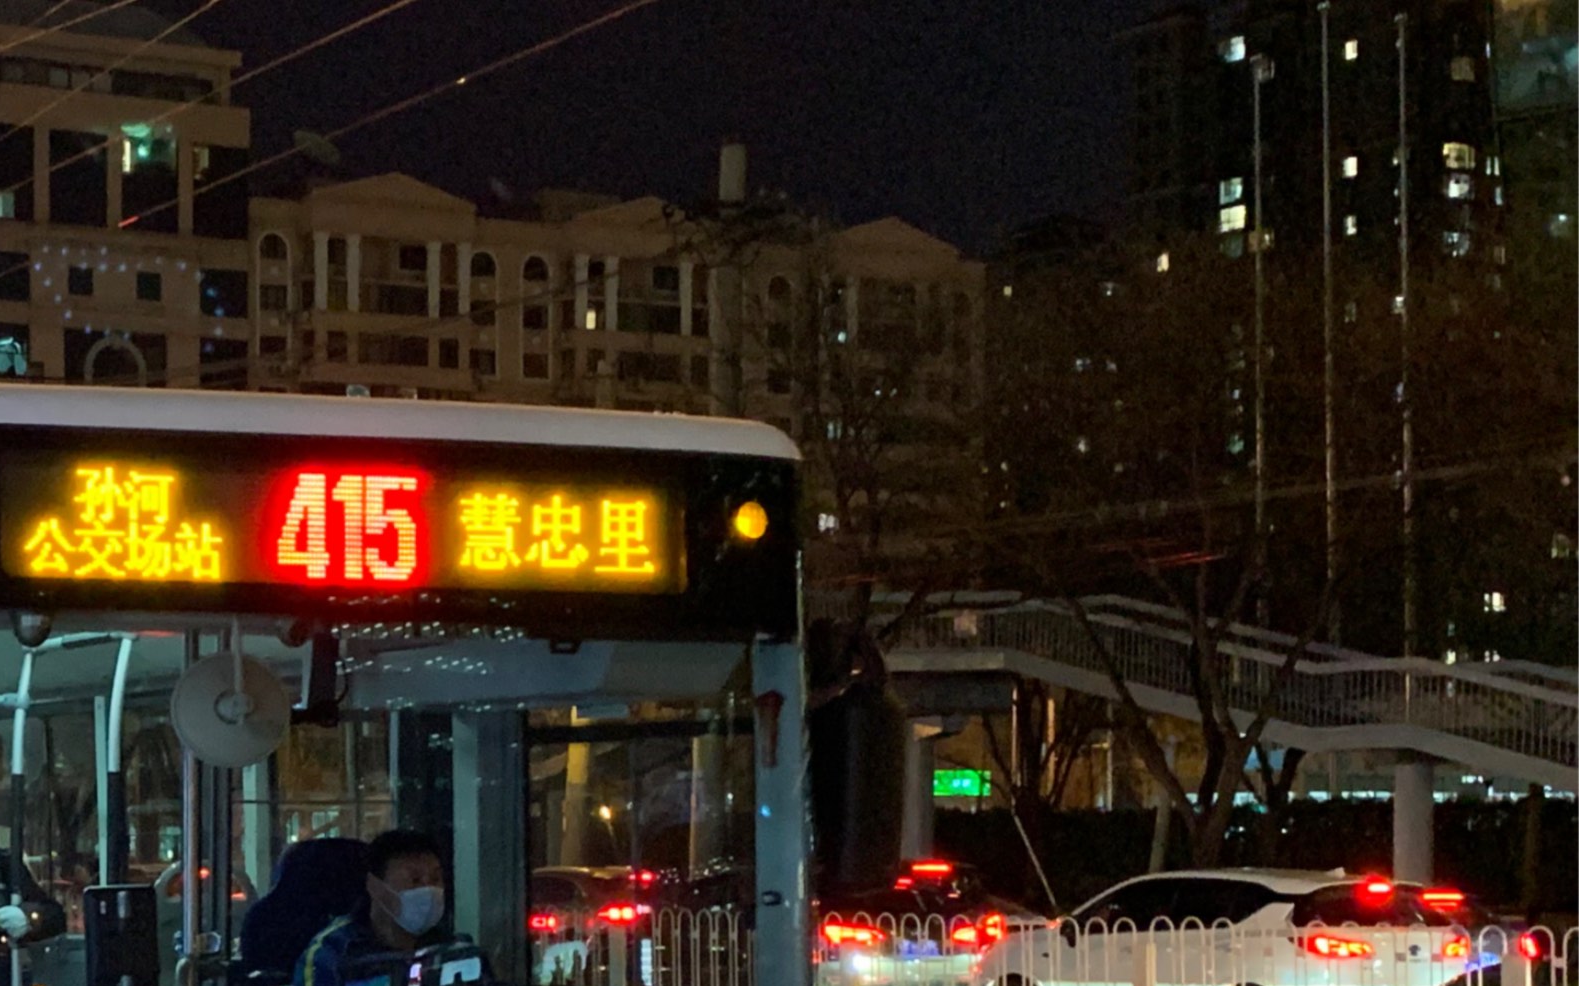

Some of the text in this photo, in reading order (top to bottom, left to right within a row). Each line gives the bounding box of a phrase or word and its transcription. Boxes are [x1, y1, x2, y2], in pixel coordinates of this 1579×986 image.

[72, 464, 178, 524] 孙河
[276, 472, 421, 582] 415
[23, 514, 224, 583] 公交场站
[459, 491, 656, 576] 慧忠里
